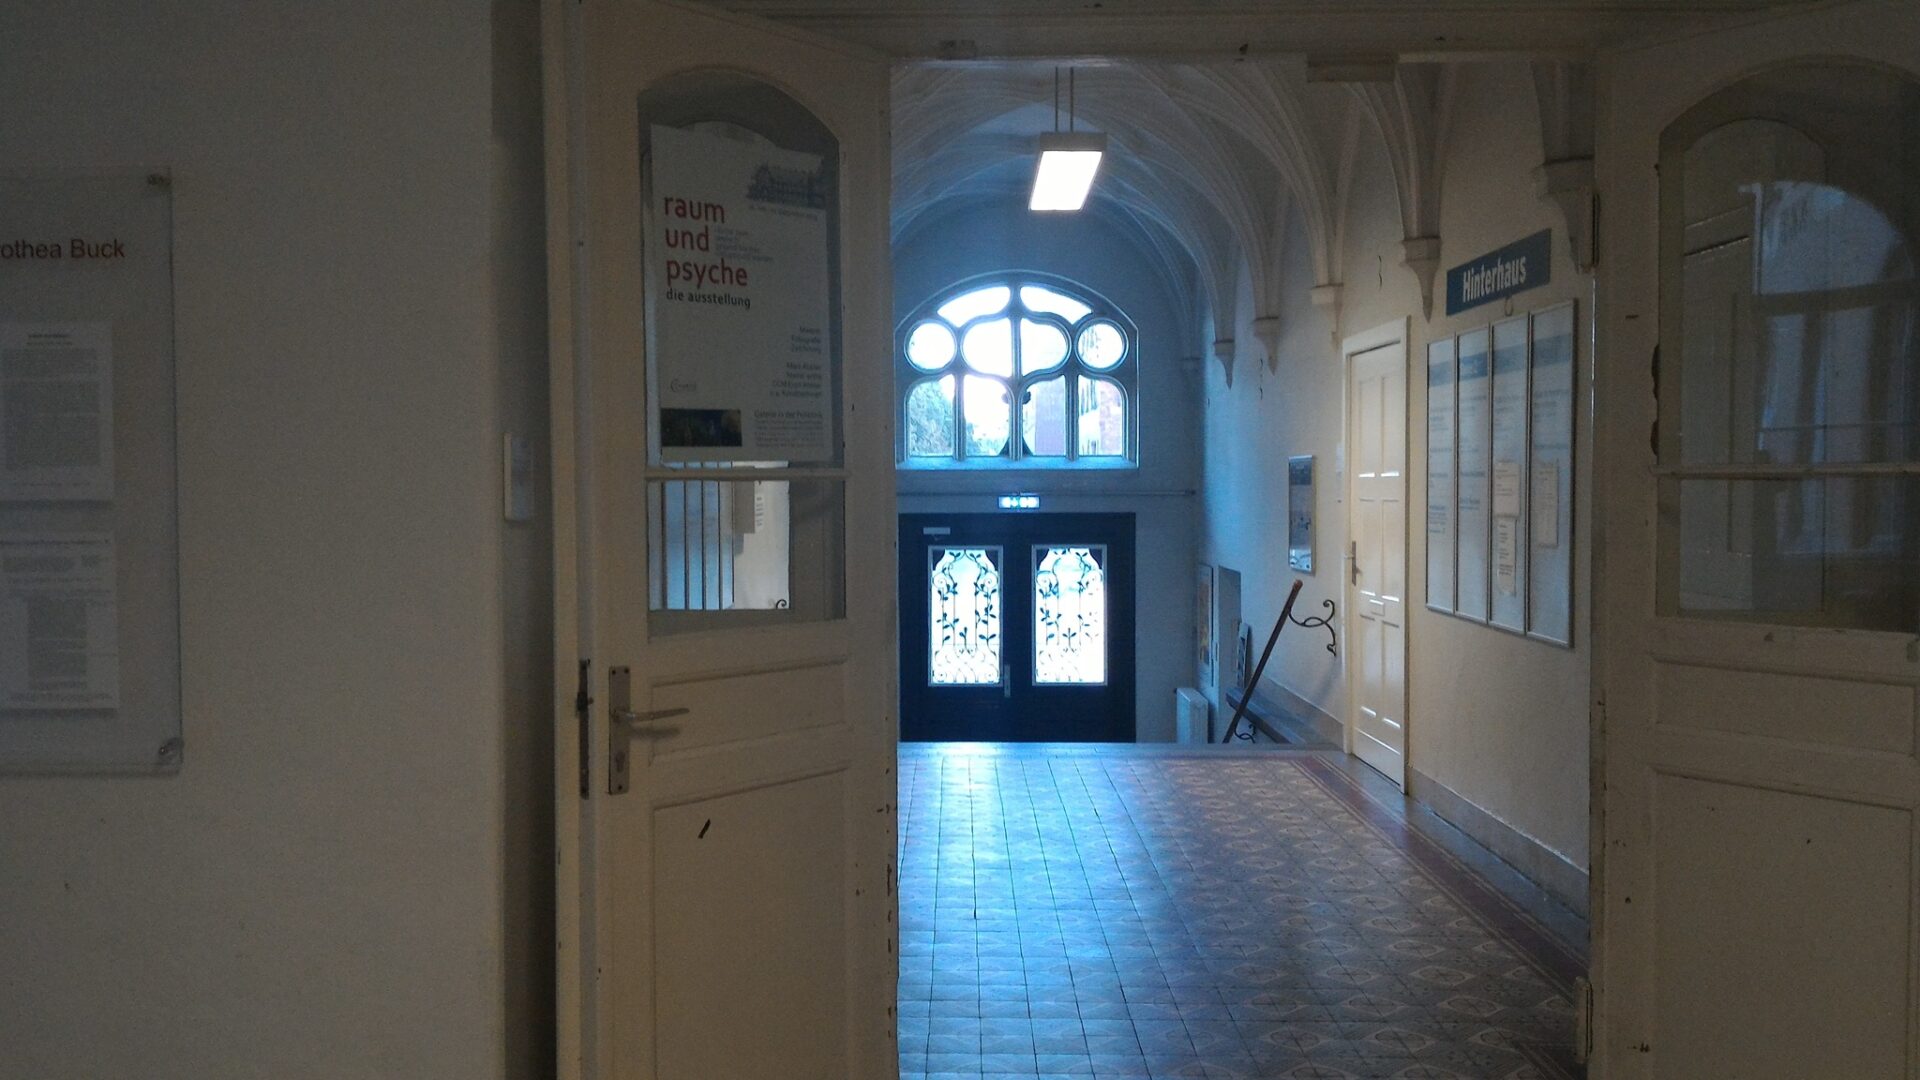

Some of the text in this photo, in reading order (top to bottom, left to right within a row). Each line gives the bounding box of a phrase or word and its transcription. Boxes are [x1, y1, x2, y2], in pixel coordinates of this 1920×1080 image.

[664, 196, 725, 224] raum
[0, 238, 125, 258] othea Buck
[665, 225, 710, 252] und
[666, 257, 748, 289] psyche
[1463, 256, 1527, 303] Hinterhaus
[666, 288, 751, 310] die ausstellung
